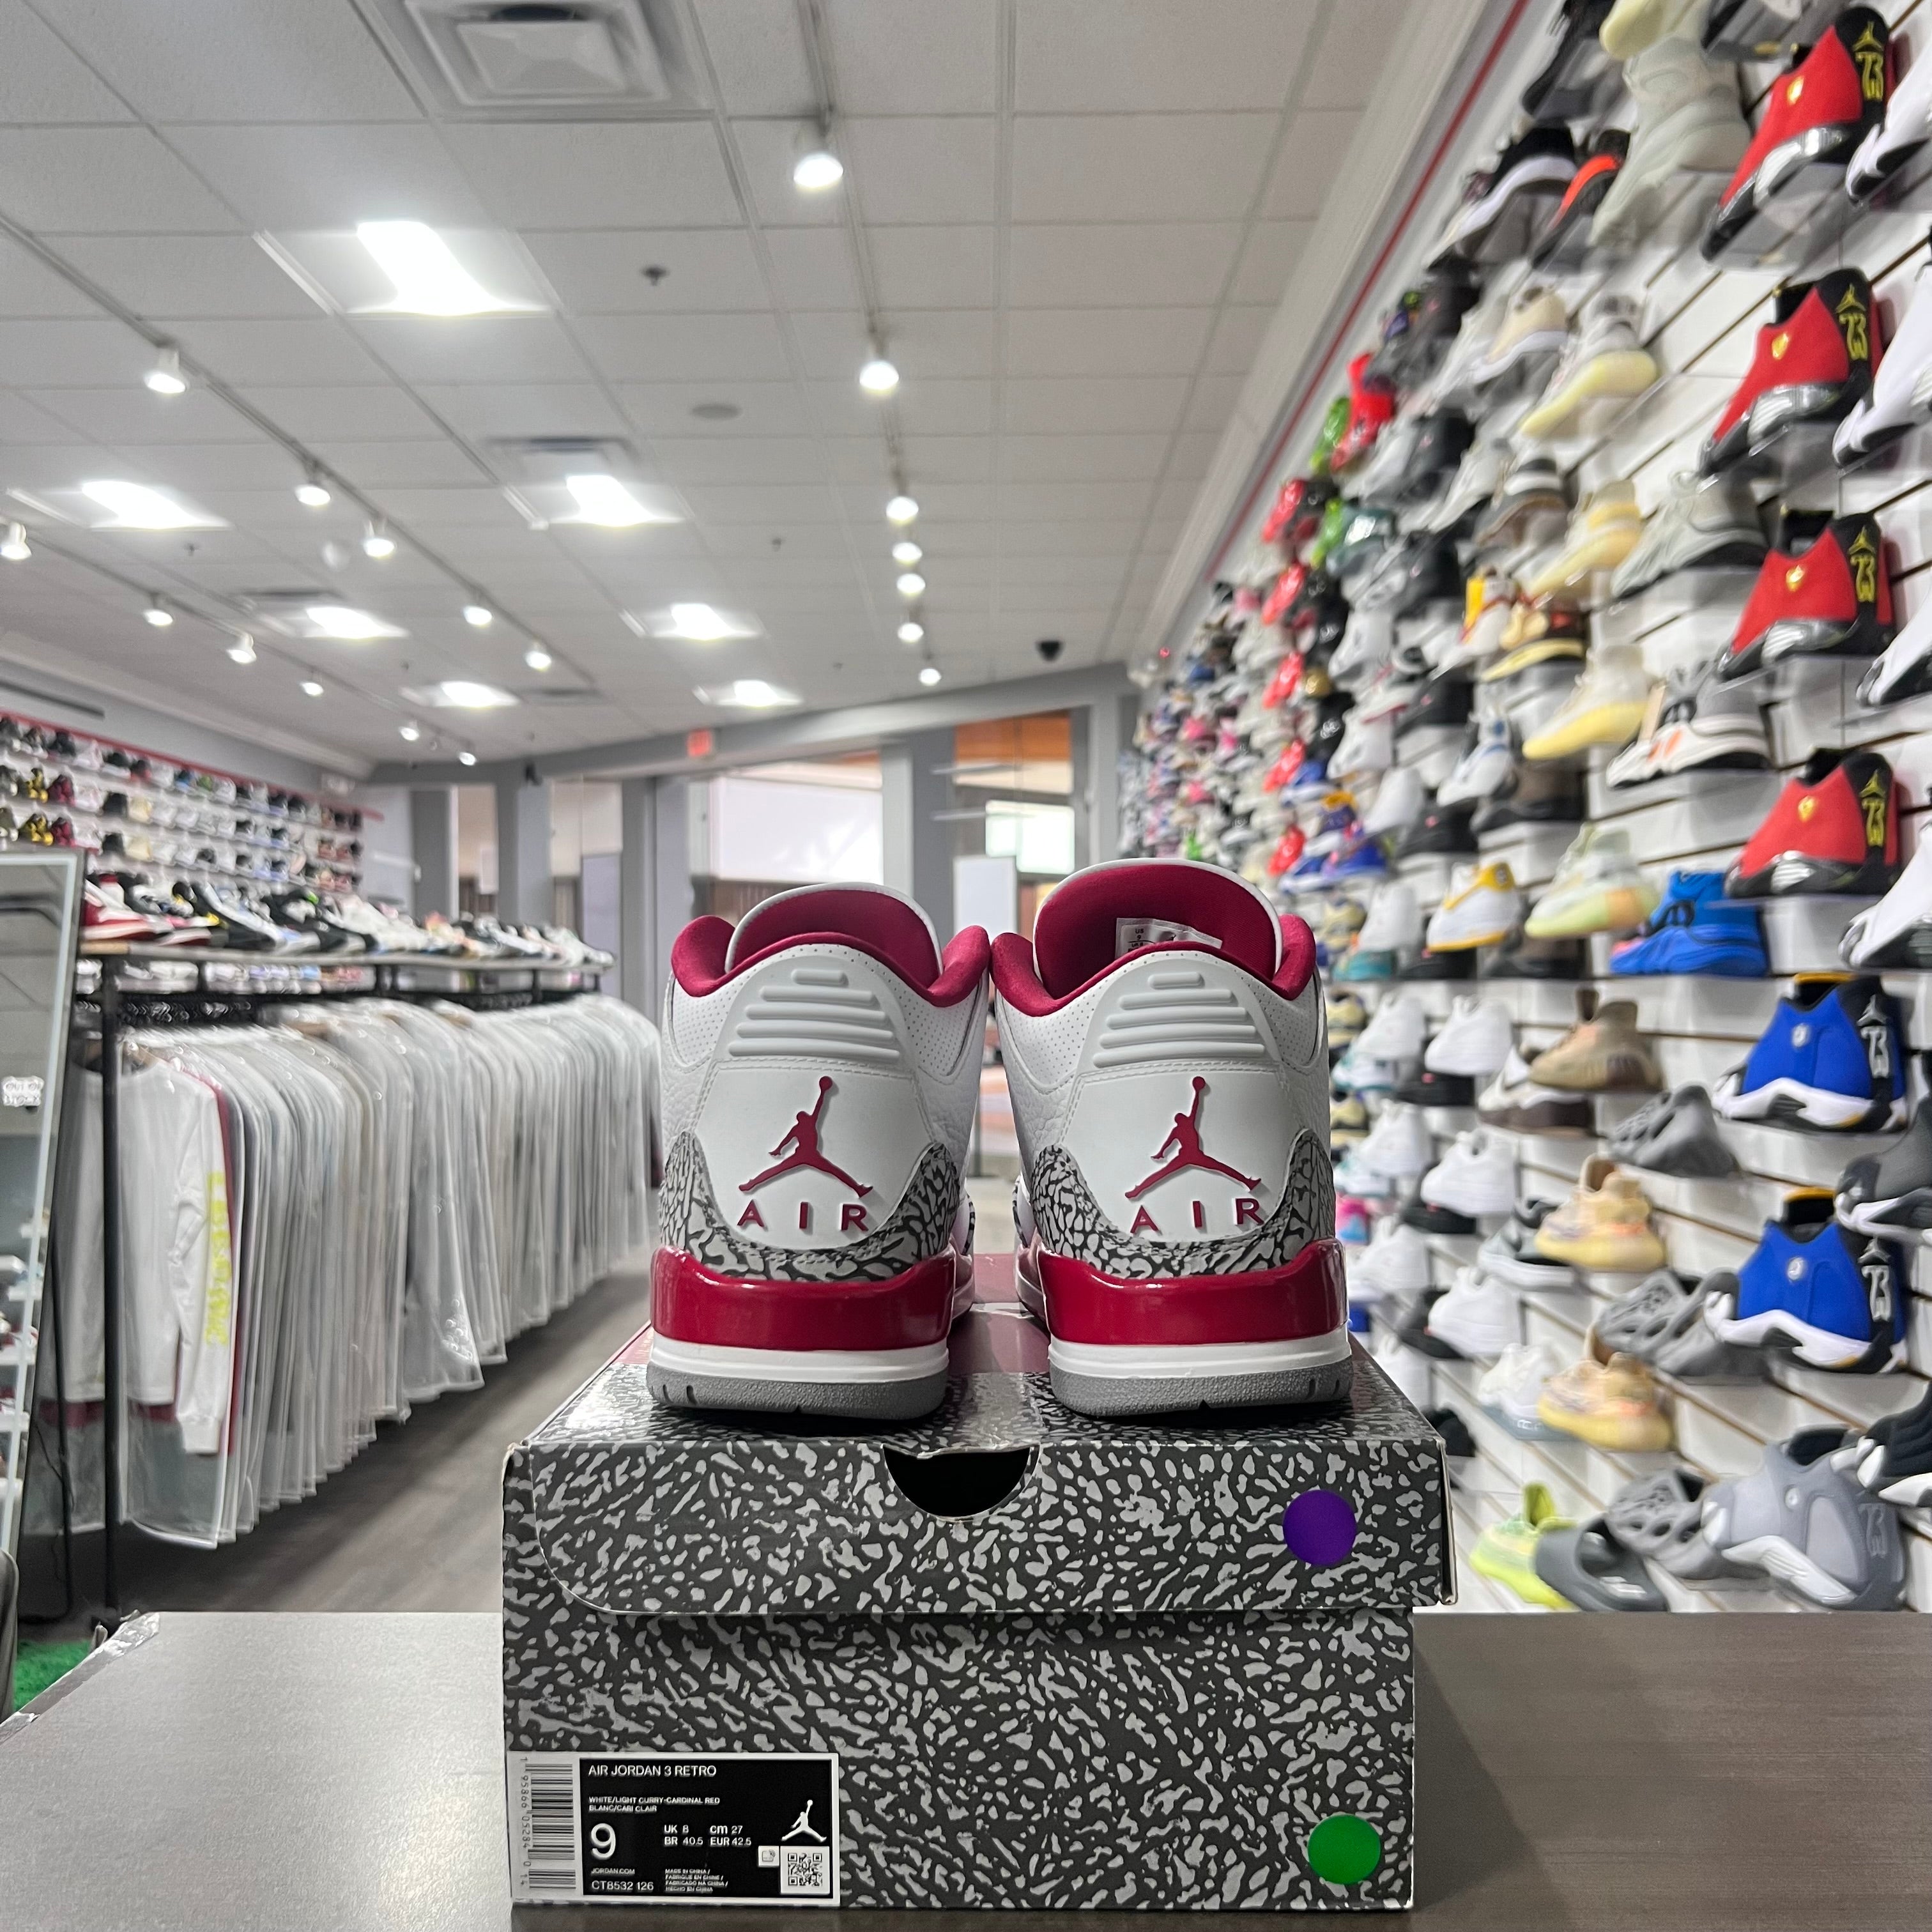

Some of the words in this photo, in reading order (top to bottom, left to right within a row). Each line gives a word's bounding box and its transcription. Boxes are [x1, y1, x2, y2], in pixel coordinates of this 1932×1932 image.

[737, 1199, 869, 1232] AIR
[1130, 1197, 1264, 1234] AIR
[588, 1765, 608, 1777] AIR
[611, 1765, 661, 1777] JORDAN
[664, 1765, 671, 1777] 3
[674, 1765, 717, 1777] RETRO
[521, 1775, 530, 1809] 95866
[588, 1796, 637, 1804] WHITE/LIGHT
[638, 1797, 703, 1805] CURRY-CARDINAL
[705, 1797, 720, 1805] RED
[635, 1805, 657, 1814] CLAIR
[521, 1816, 531, 1849] 05284
[664, 1824, 678, 1834] UK
[682, 1824, 689, 1834] 8
[710, 1825, 728, 1835] cm
[731, 1825, 743, 1834] 27
[590, 1823, 617, 1860] 9
[664, 1836, 678, 1846] BR
[682, 1836, 703, 1846] 40.5
[710, 1836, 730, 1846] EUR
[732, 1837, 752, 1846] 42.5
[592, 1880, 633, 1891] CT8532
[637, 1881, 654, 1891] 126
